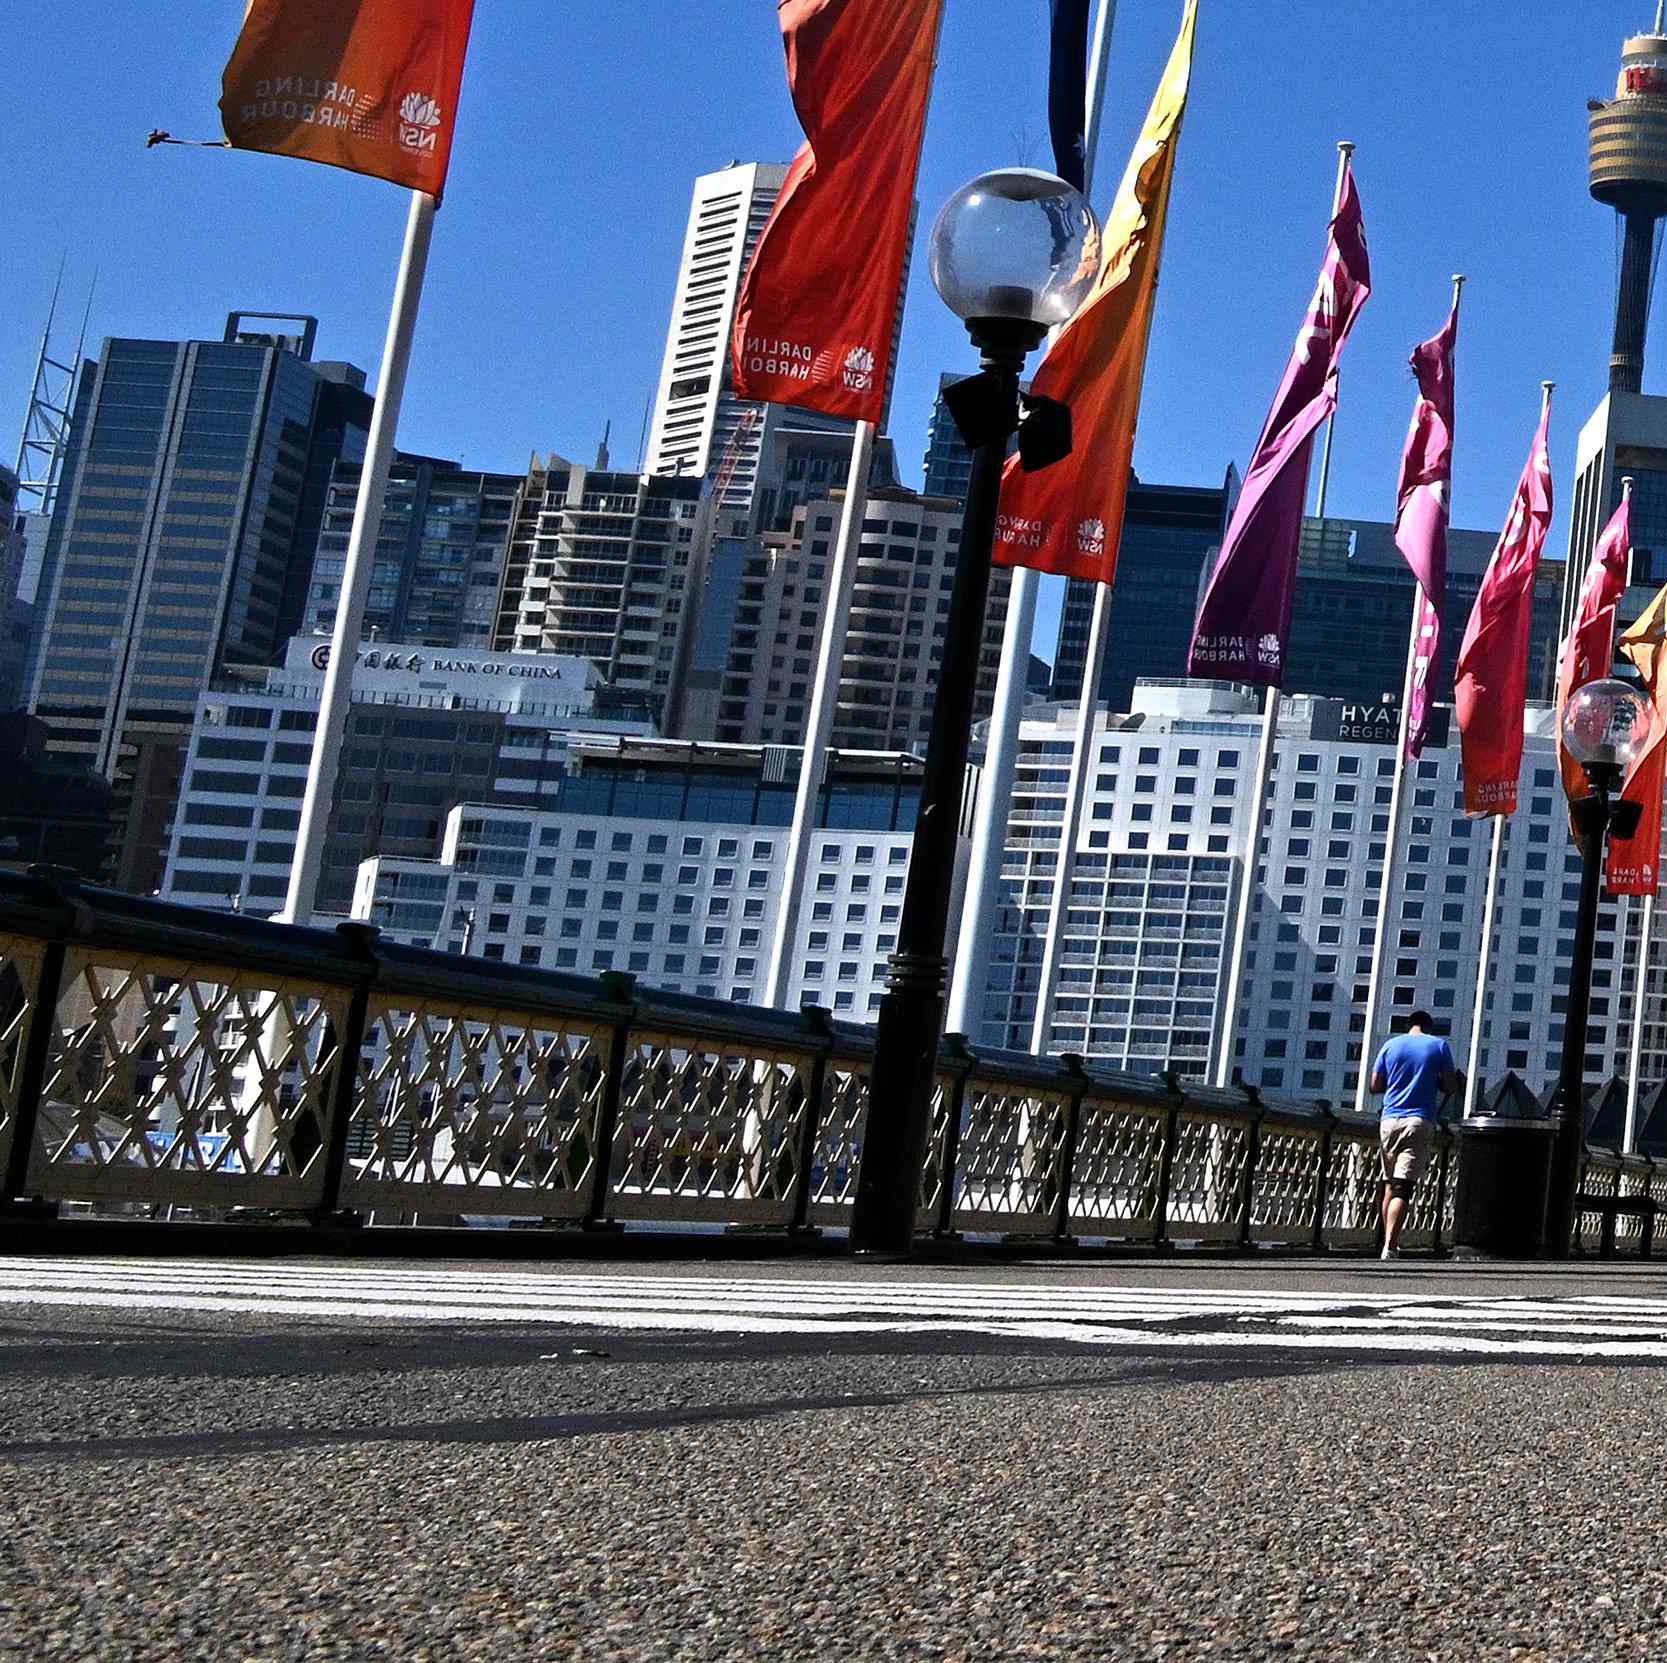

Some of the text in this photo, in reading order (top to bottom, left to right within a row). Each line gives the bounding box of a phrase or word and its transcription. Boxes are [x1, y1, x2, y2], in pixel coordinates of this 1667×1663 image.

[431, 659, 563, 680] BANK OF CHINA
[1341, 705, 1403, 725] HYAT
[1339, 724, 1397, 739] REGEN
